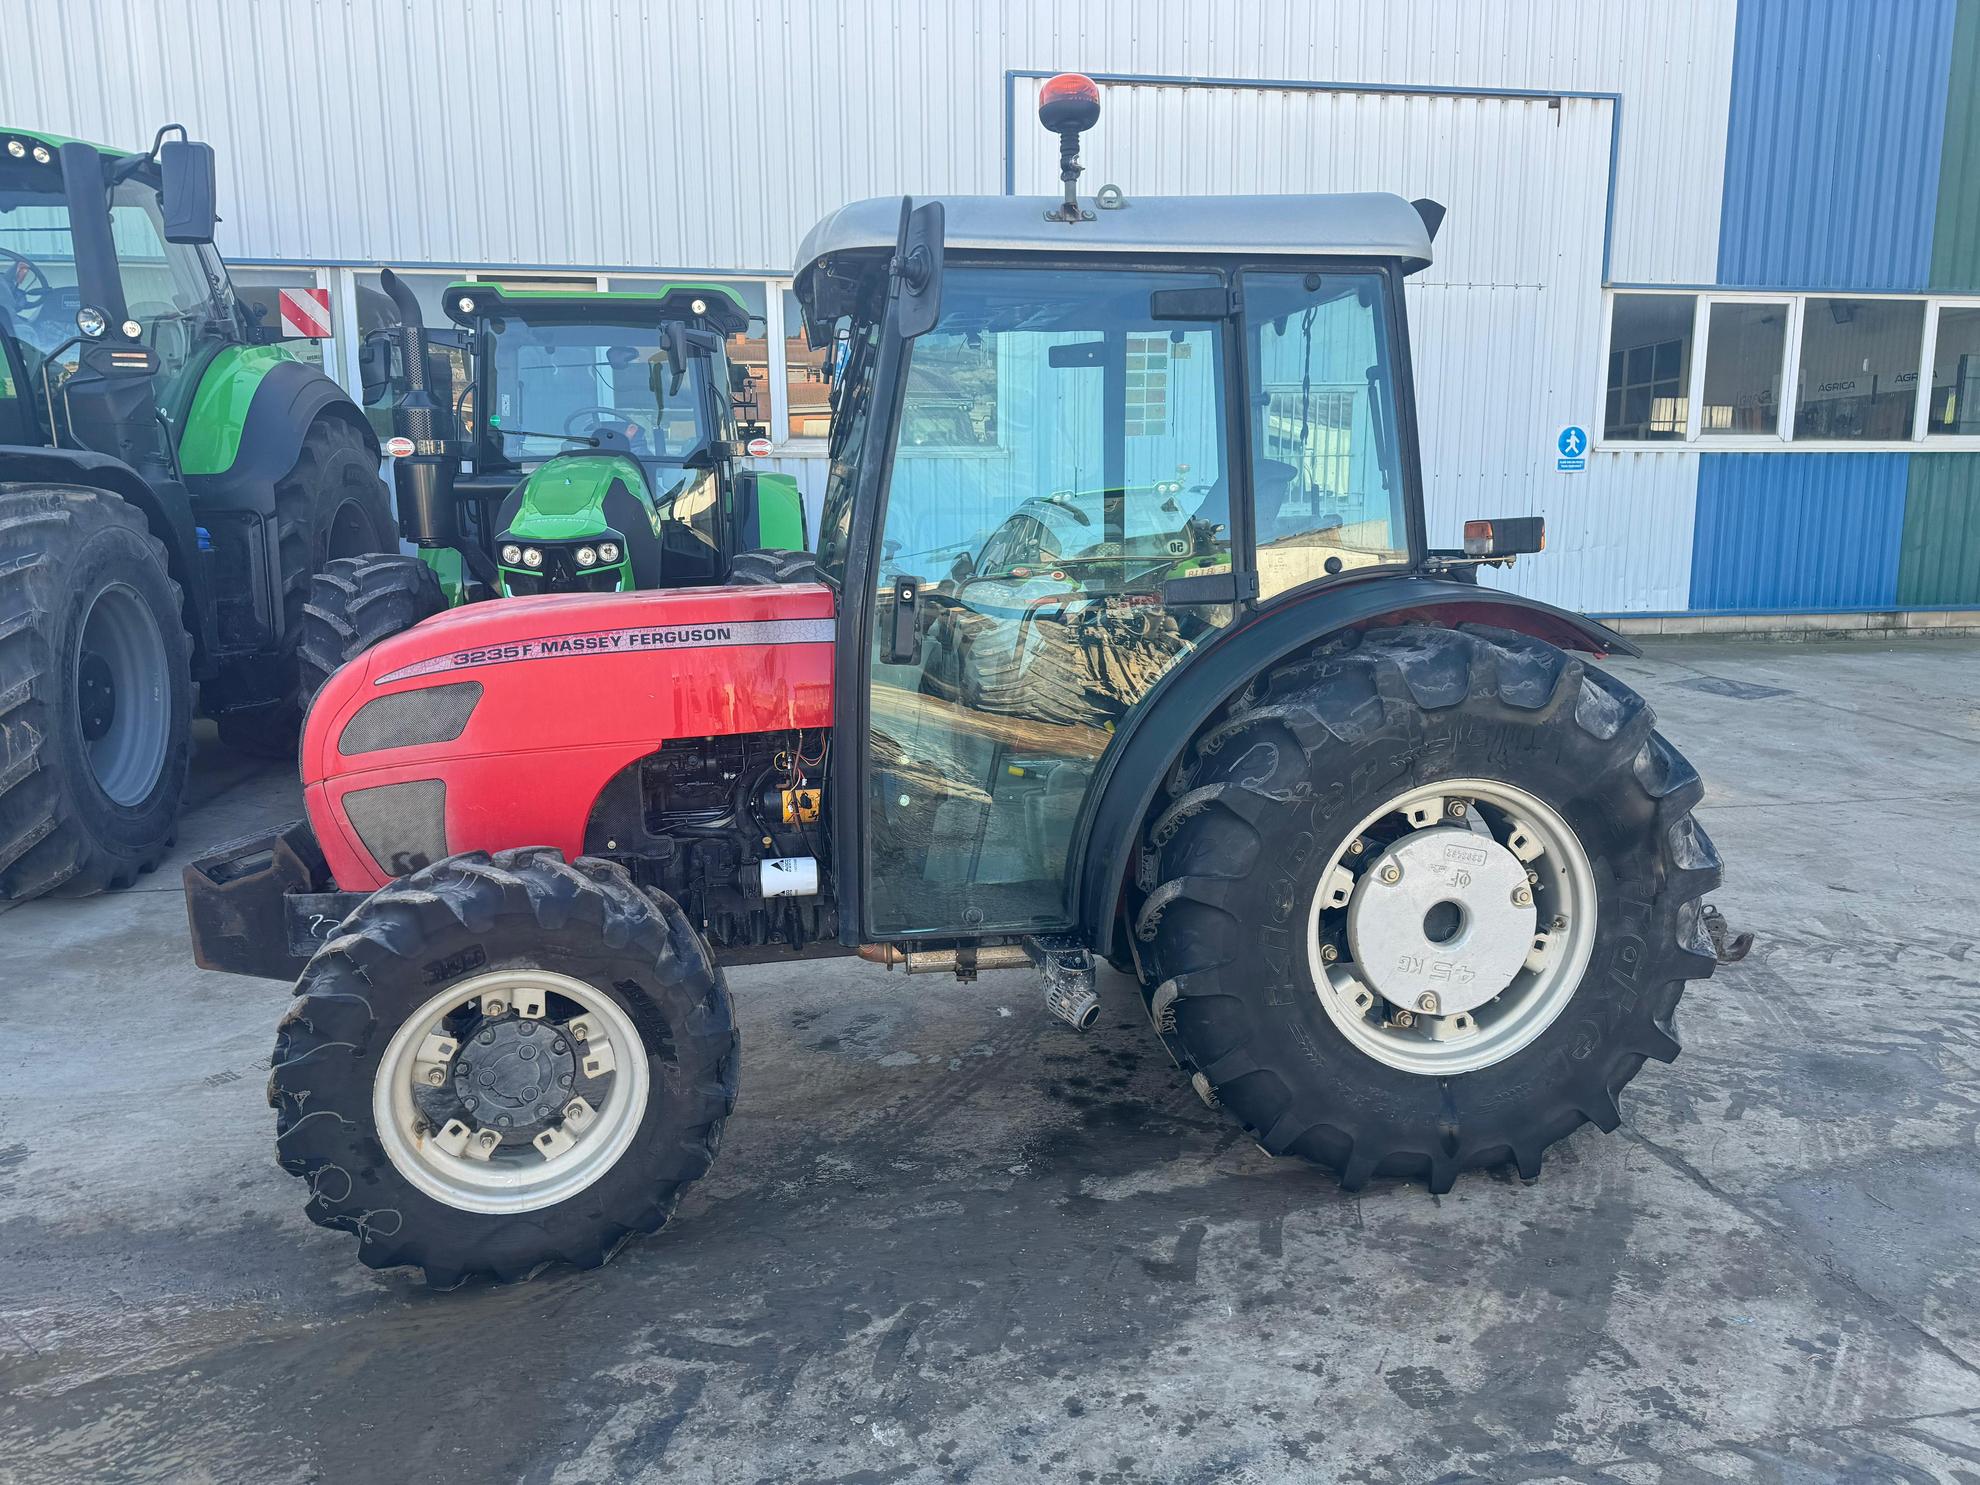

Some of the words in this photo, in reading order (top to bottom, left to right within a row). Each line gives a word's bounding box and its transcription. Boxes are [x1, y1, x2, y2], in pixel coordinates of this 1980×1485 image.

[1817, 380, 1856, 393] AGRICA
[1894, 370, 1938, 383] AGRA
[541, 635, 622, 653] MASSEY
[629, 627, 731, 646] FERGUSON
[1398, 955, 1425, 975] KG
[1429, 960, 1476, 984] 45
